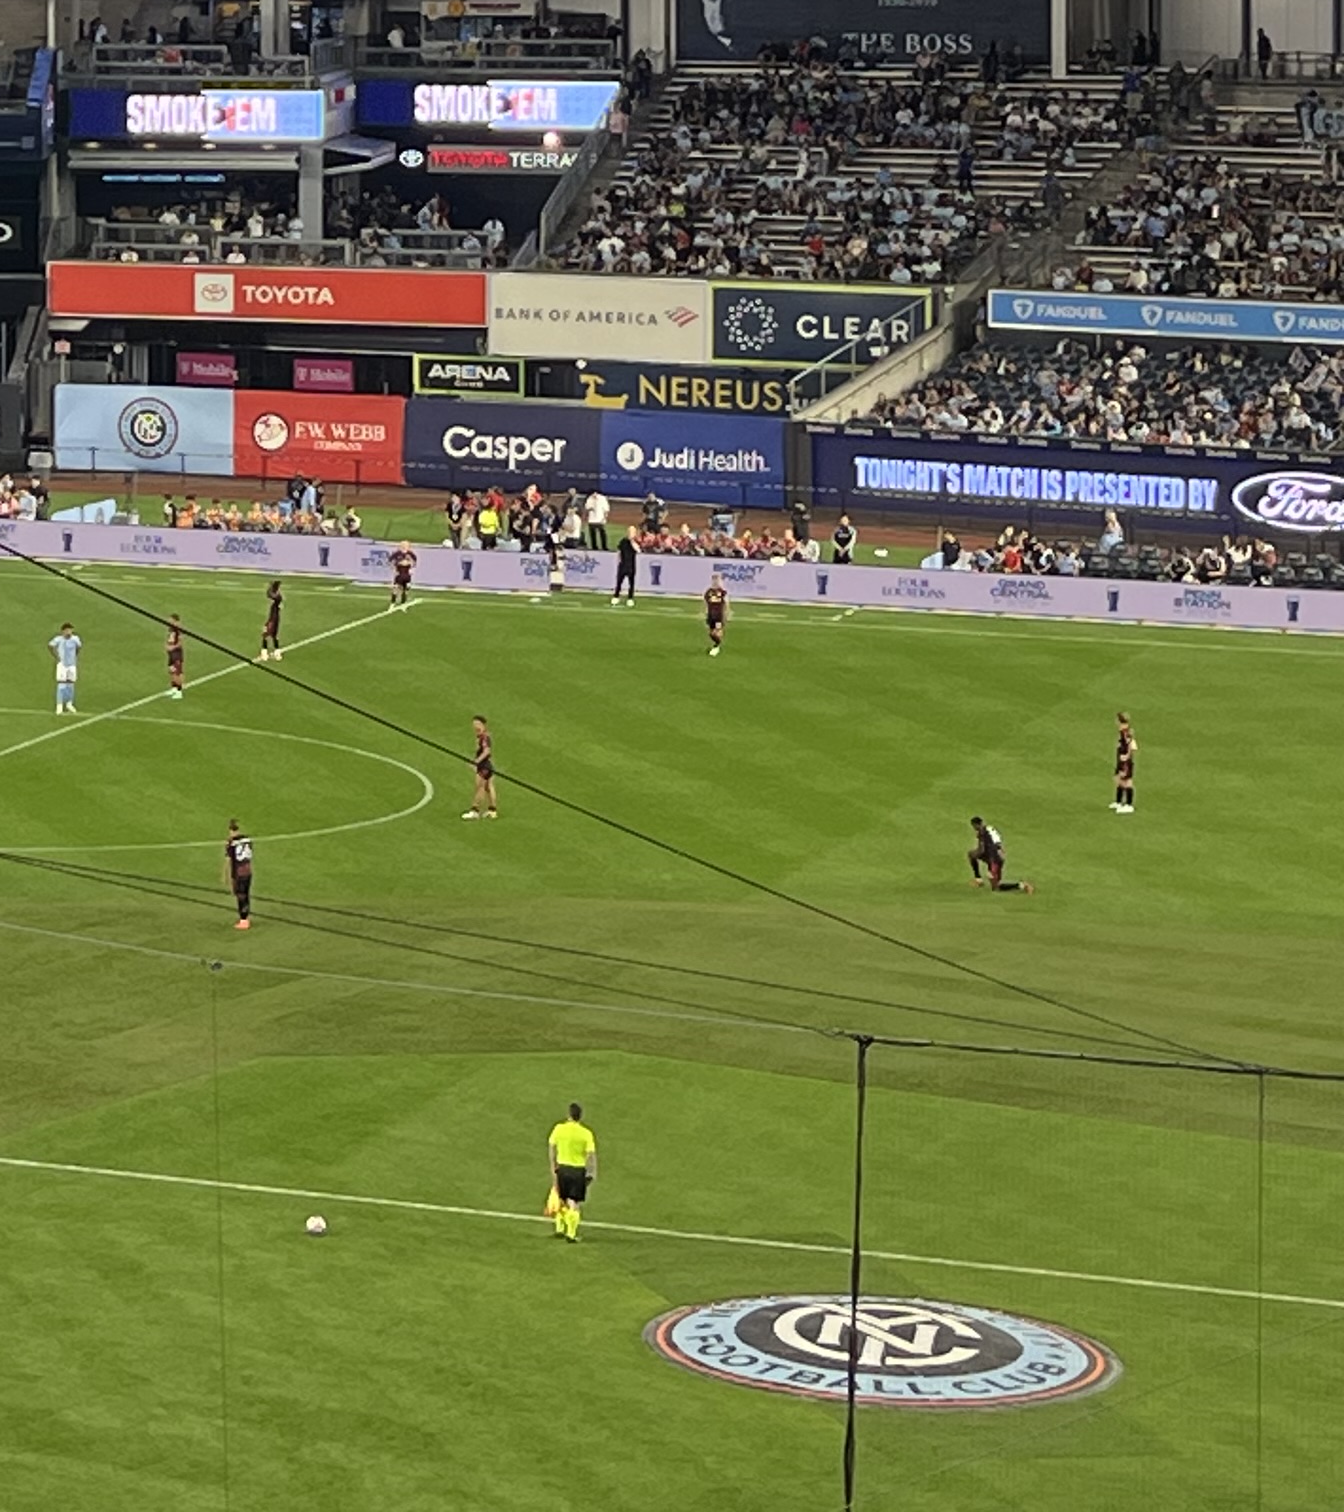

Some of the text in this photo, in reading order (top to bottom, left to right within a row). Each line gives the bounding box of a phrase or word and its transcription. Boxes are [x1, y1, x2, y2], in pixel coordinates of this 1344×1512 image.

[905, 33, 973, 54] BOSS
[126, 94, 224, 134] SMOKE
[414, 85, 507, 122] SMOKE
[242, 285, 334, 306] TOYOTA
[494, 307, 658, 326] BANK OF AMERICA
[1036, 303, 1107, 320] FANDUEL
[1165, 310, 1238, 327] FANDUEL
[796, 315, 909, 343] CLEAR
[427, 363, 511, 381] ARENA
[639, 376, 783, 411] NEREUS
[331, 422, 387, 442] WEBB
[442, 426, 566, 469] Casper
[647, 446, 695, 470] Judi
[854, 457, 1218, 511] TONIGHT'S MATCH IS PRESENTED BY
[685, 1333, 1067, 1396] FOOTBALL CLUB
